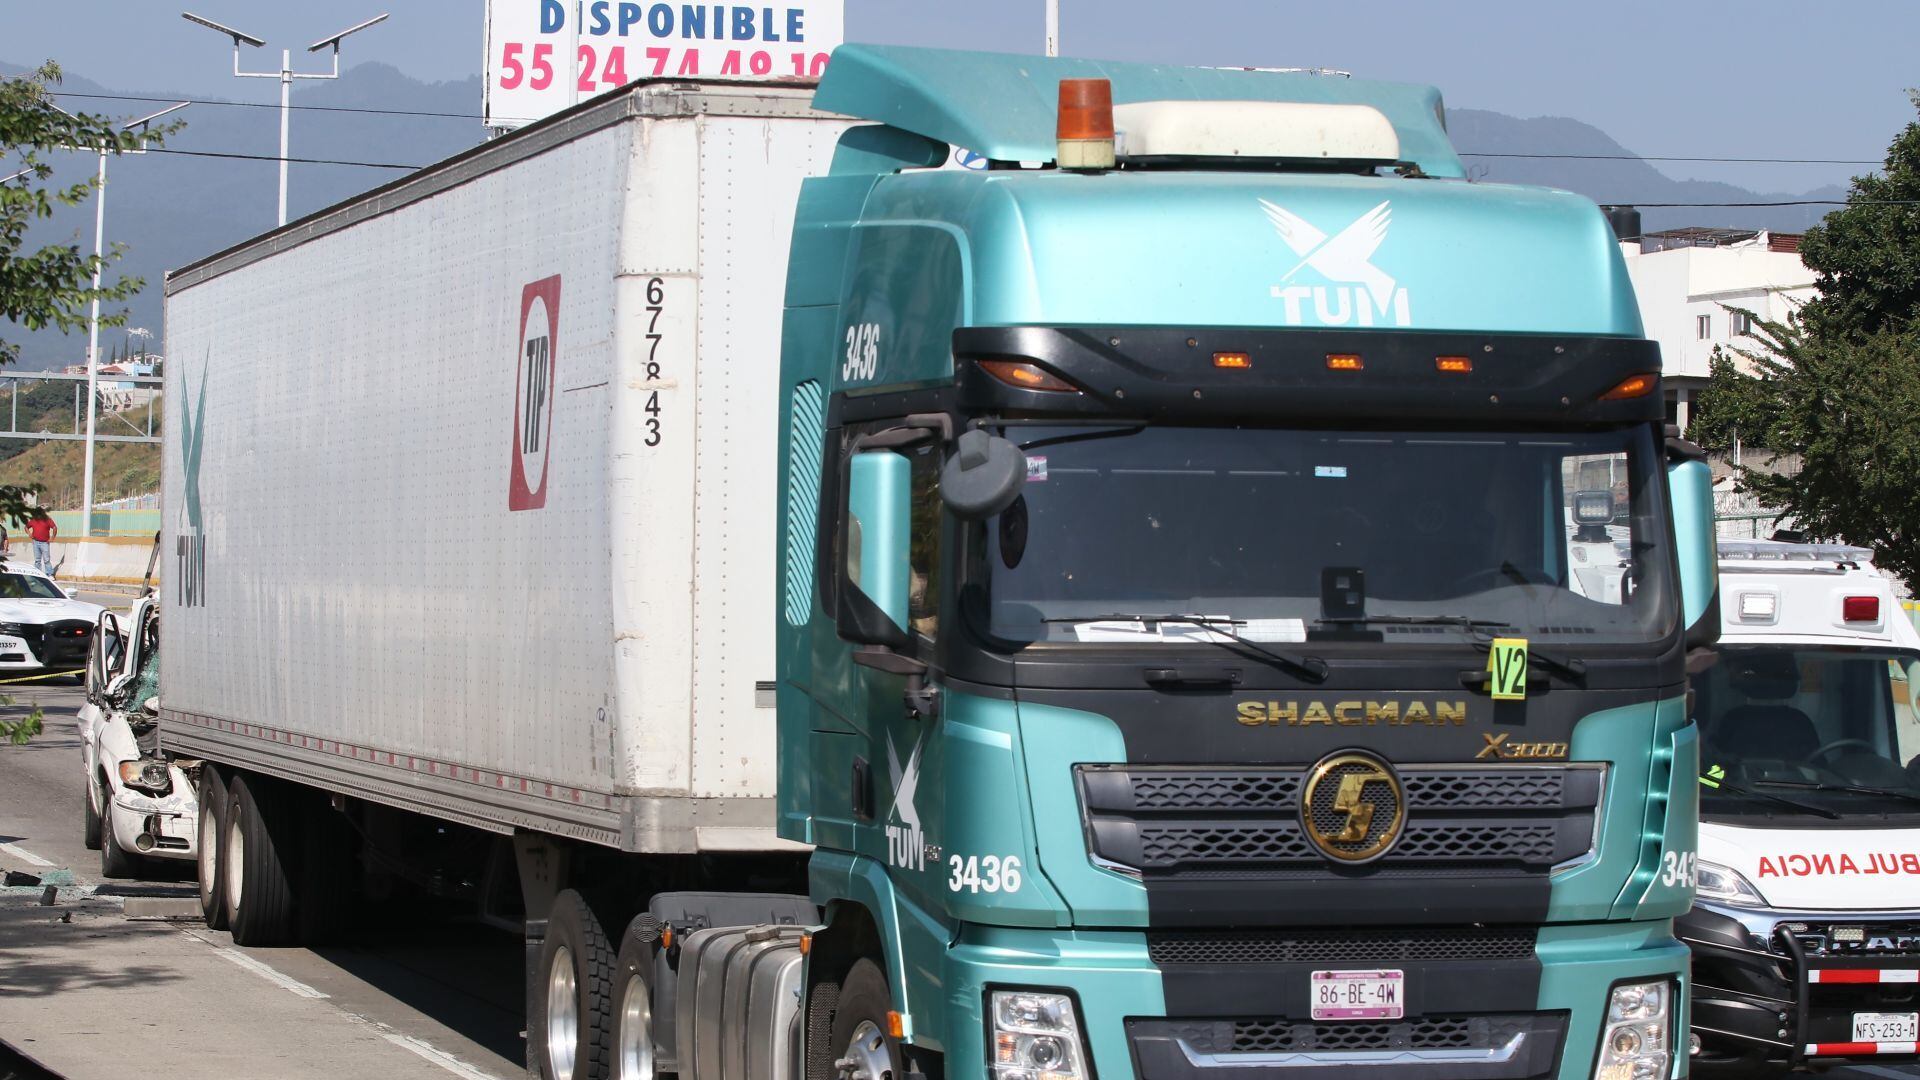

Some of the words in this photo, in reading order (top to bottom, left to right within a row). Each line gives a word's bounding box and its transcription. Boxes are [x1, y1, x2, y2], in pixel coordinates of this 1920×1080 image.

[500, 43, 553, 91] 55
[578, 46, 627, 92] 24
[1270, 286, 1411, 326] TUM
[842, 323, 880, 382] 3436
[523, 335, 549, 454] TIP
[176, 533, 206, 609] TUM
[1495, 647, 1526, 694] V2
[1236, 701, 1466, 727] SHACMAN
[1475, 732, 1568, 759] X3000
[885, 825, 925, 872] TUM
[948, 854, 1022, 893] 3436
[1320, 983, 1395, 1004] 86-BE-4W
[1855, 1022, 1915, 1039] NFS-253-A
